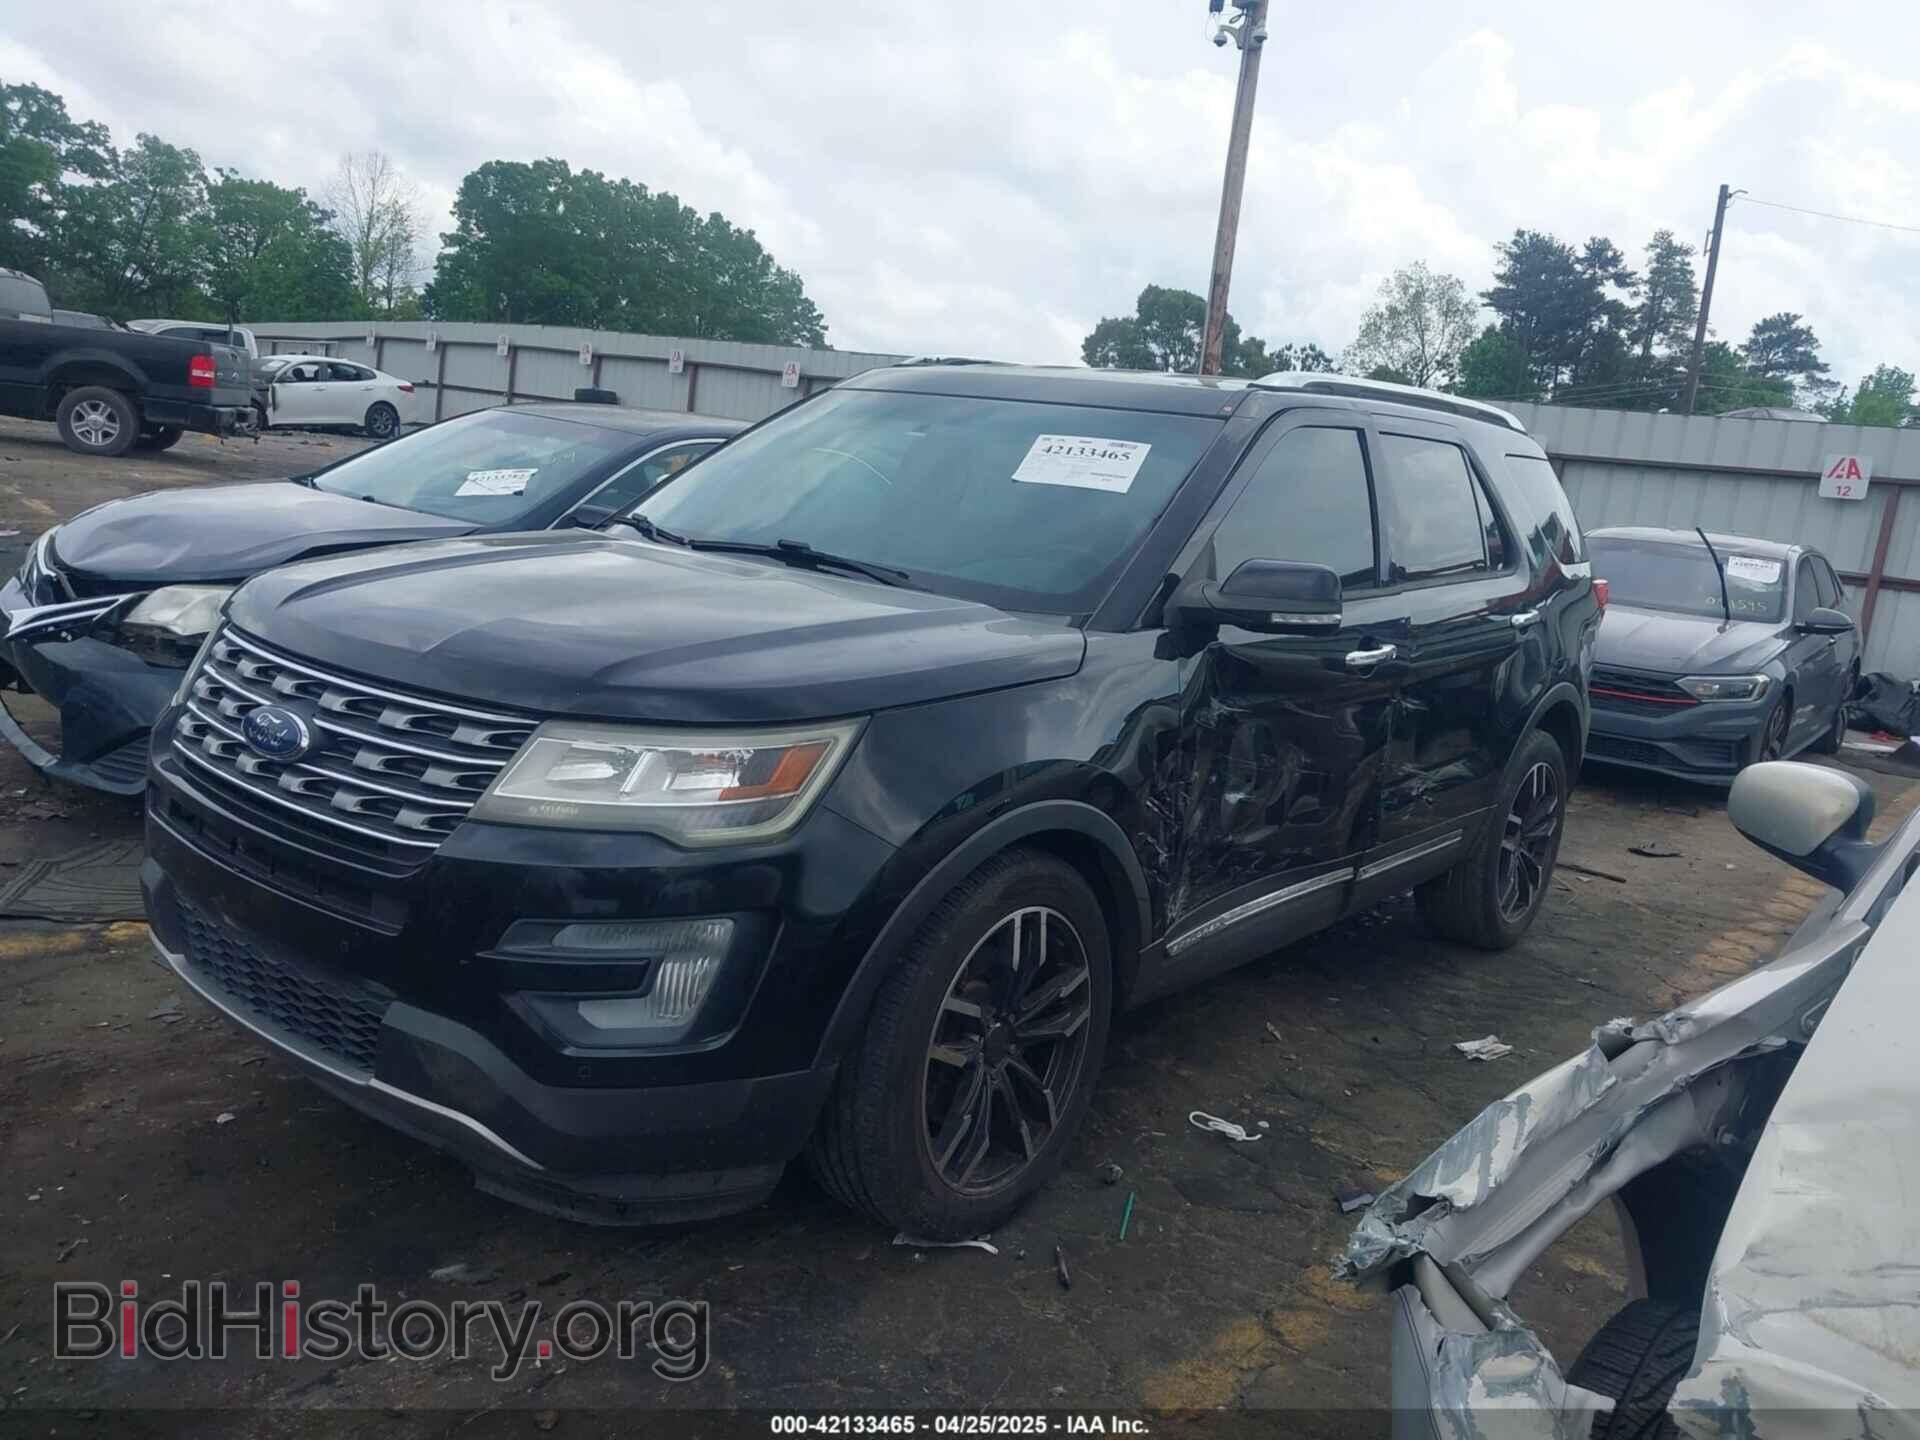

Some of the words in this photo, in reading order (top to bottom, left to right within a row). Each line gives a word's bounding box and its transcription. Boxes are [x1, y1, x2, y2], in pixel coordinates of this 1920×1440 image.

[1042, 444, 1131, 461] 42133465
[1835, 485, 1851, 497] 12
[248, 712, 289, 746] Ford
